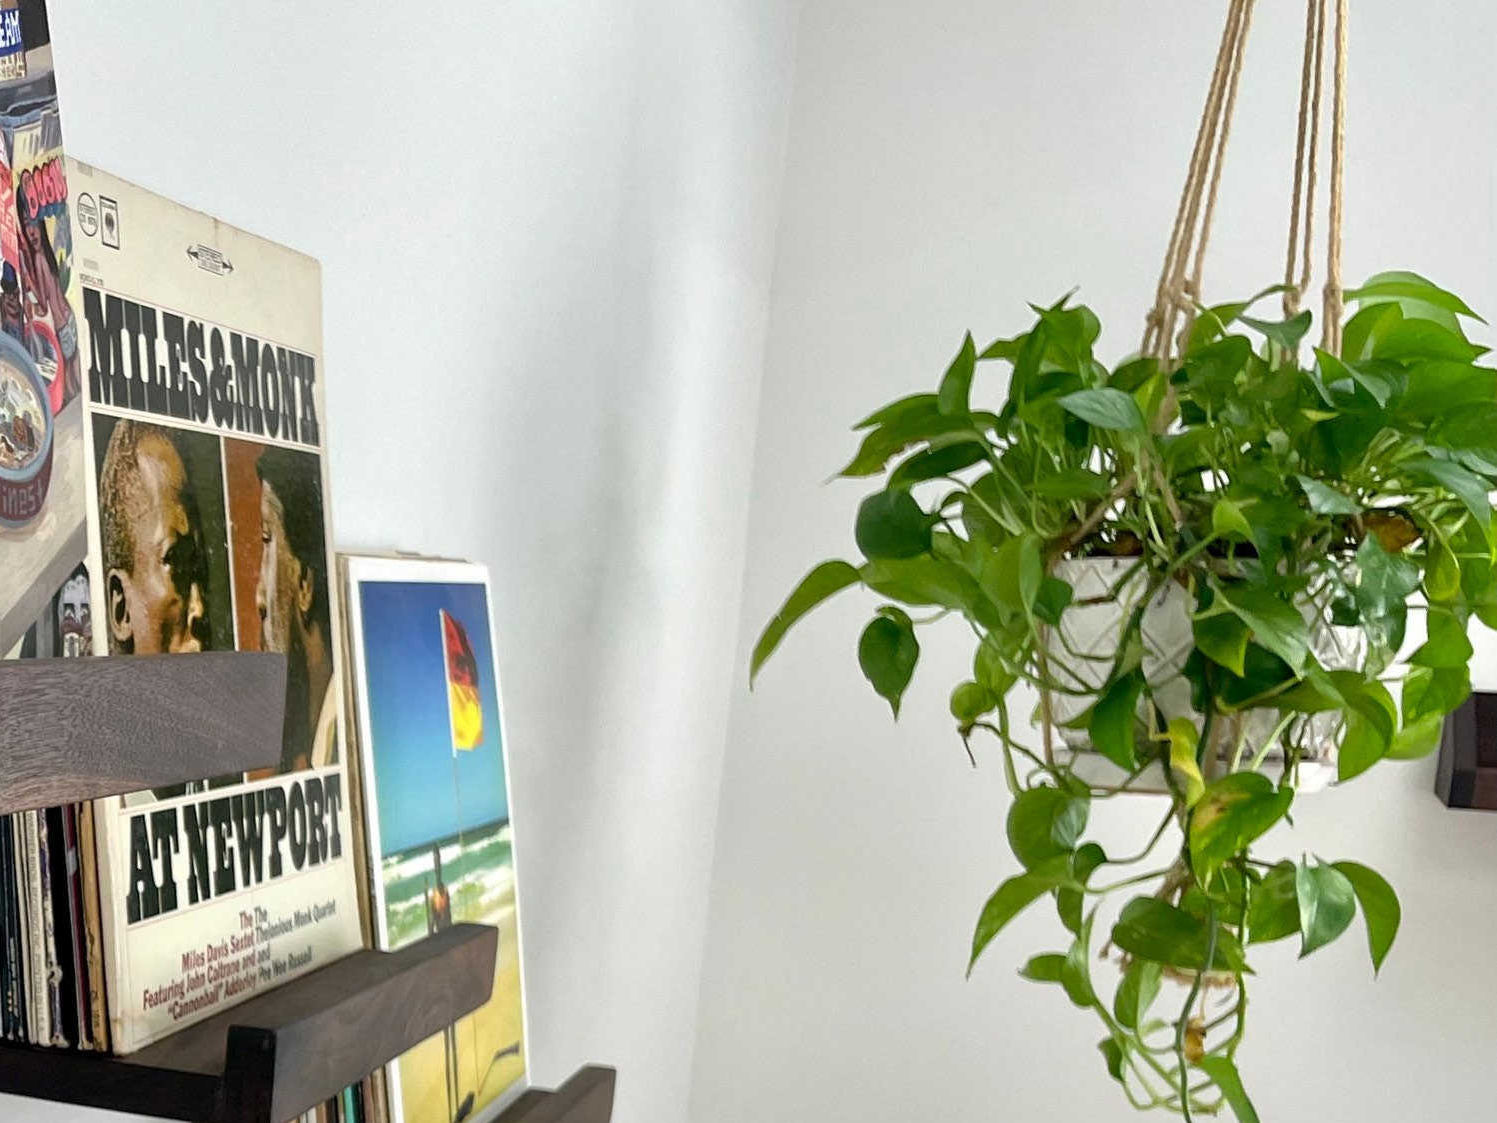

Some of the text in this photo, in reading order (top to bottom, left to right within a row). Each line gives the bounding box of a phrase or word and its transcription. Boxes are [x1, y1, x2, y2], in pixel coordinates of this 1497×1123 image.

[126, 773, 343, 925] AT NEWPORT
[239, 910, 254, 930] The
[254, 905, 268, 926] The
[255, 898, 336, 944] Thelonious Monk Quartet
[182, 931, 255, 974] Miles Davis Sextet
[257, 942, 271, 963] and
[258, 945, 313, 983] Pee Wee Russell
[143, 949, 256, 1010] Featuring John Coltrane and
[223, 971, 258, 999] Adderley
